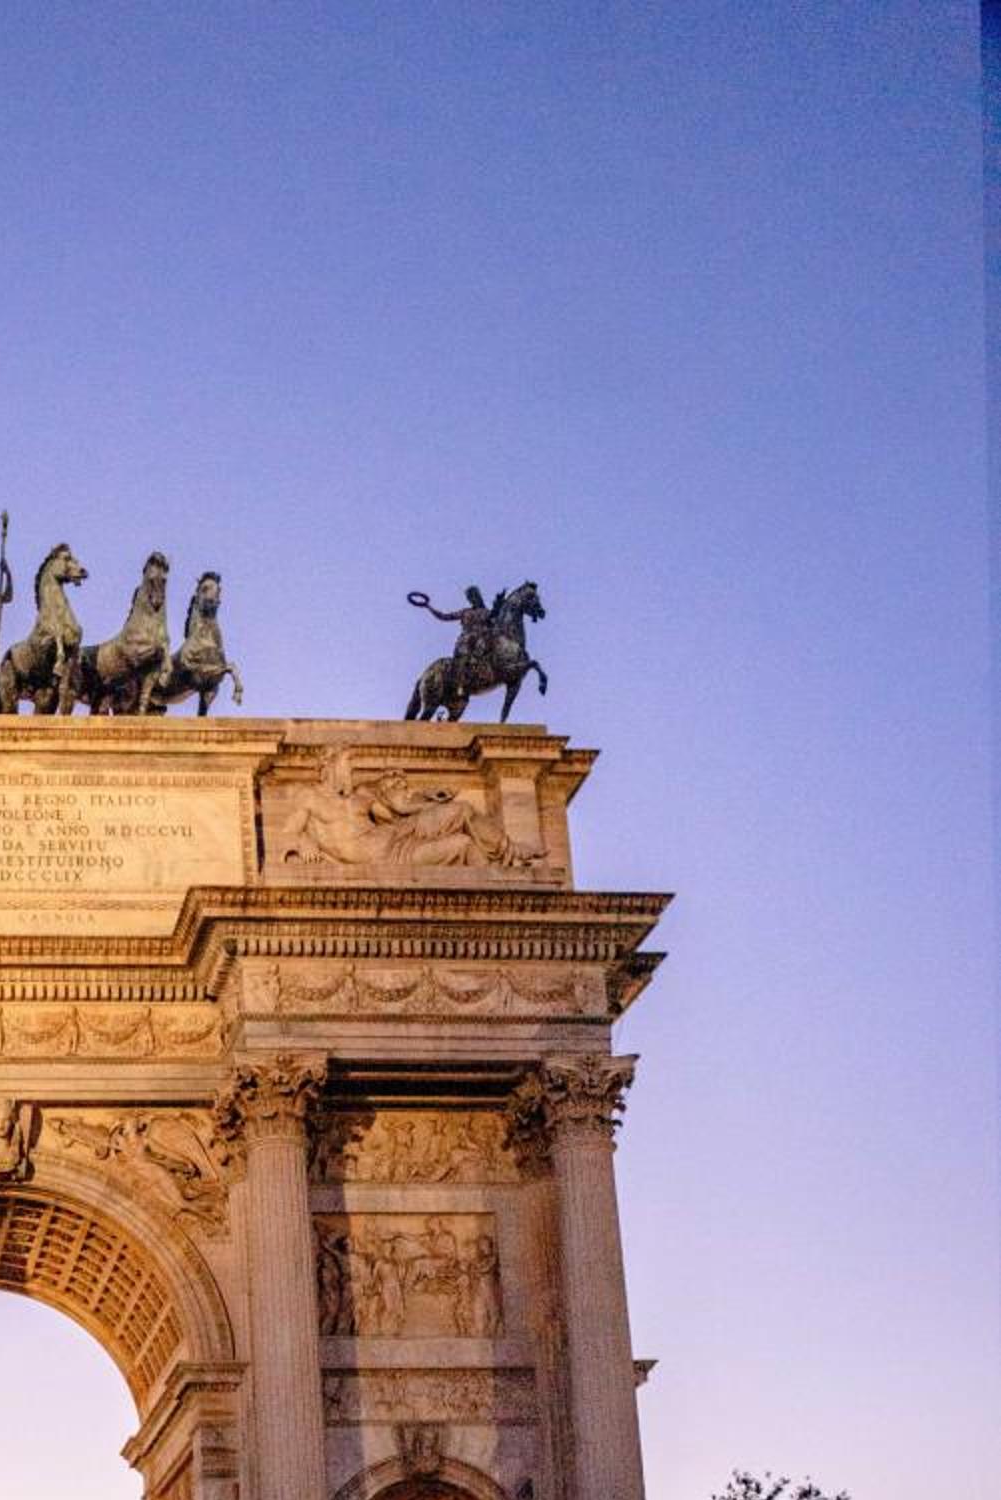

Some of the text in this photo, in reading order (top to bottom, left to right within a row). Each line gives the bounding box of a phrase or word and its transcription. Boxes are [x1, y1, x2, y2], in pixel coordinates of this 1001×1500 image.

[23, 794, 78, 806] REGNO
[90, 794, 156, 807] ITALICO
[2, 840, 24, 851] DA
